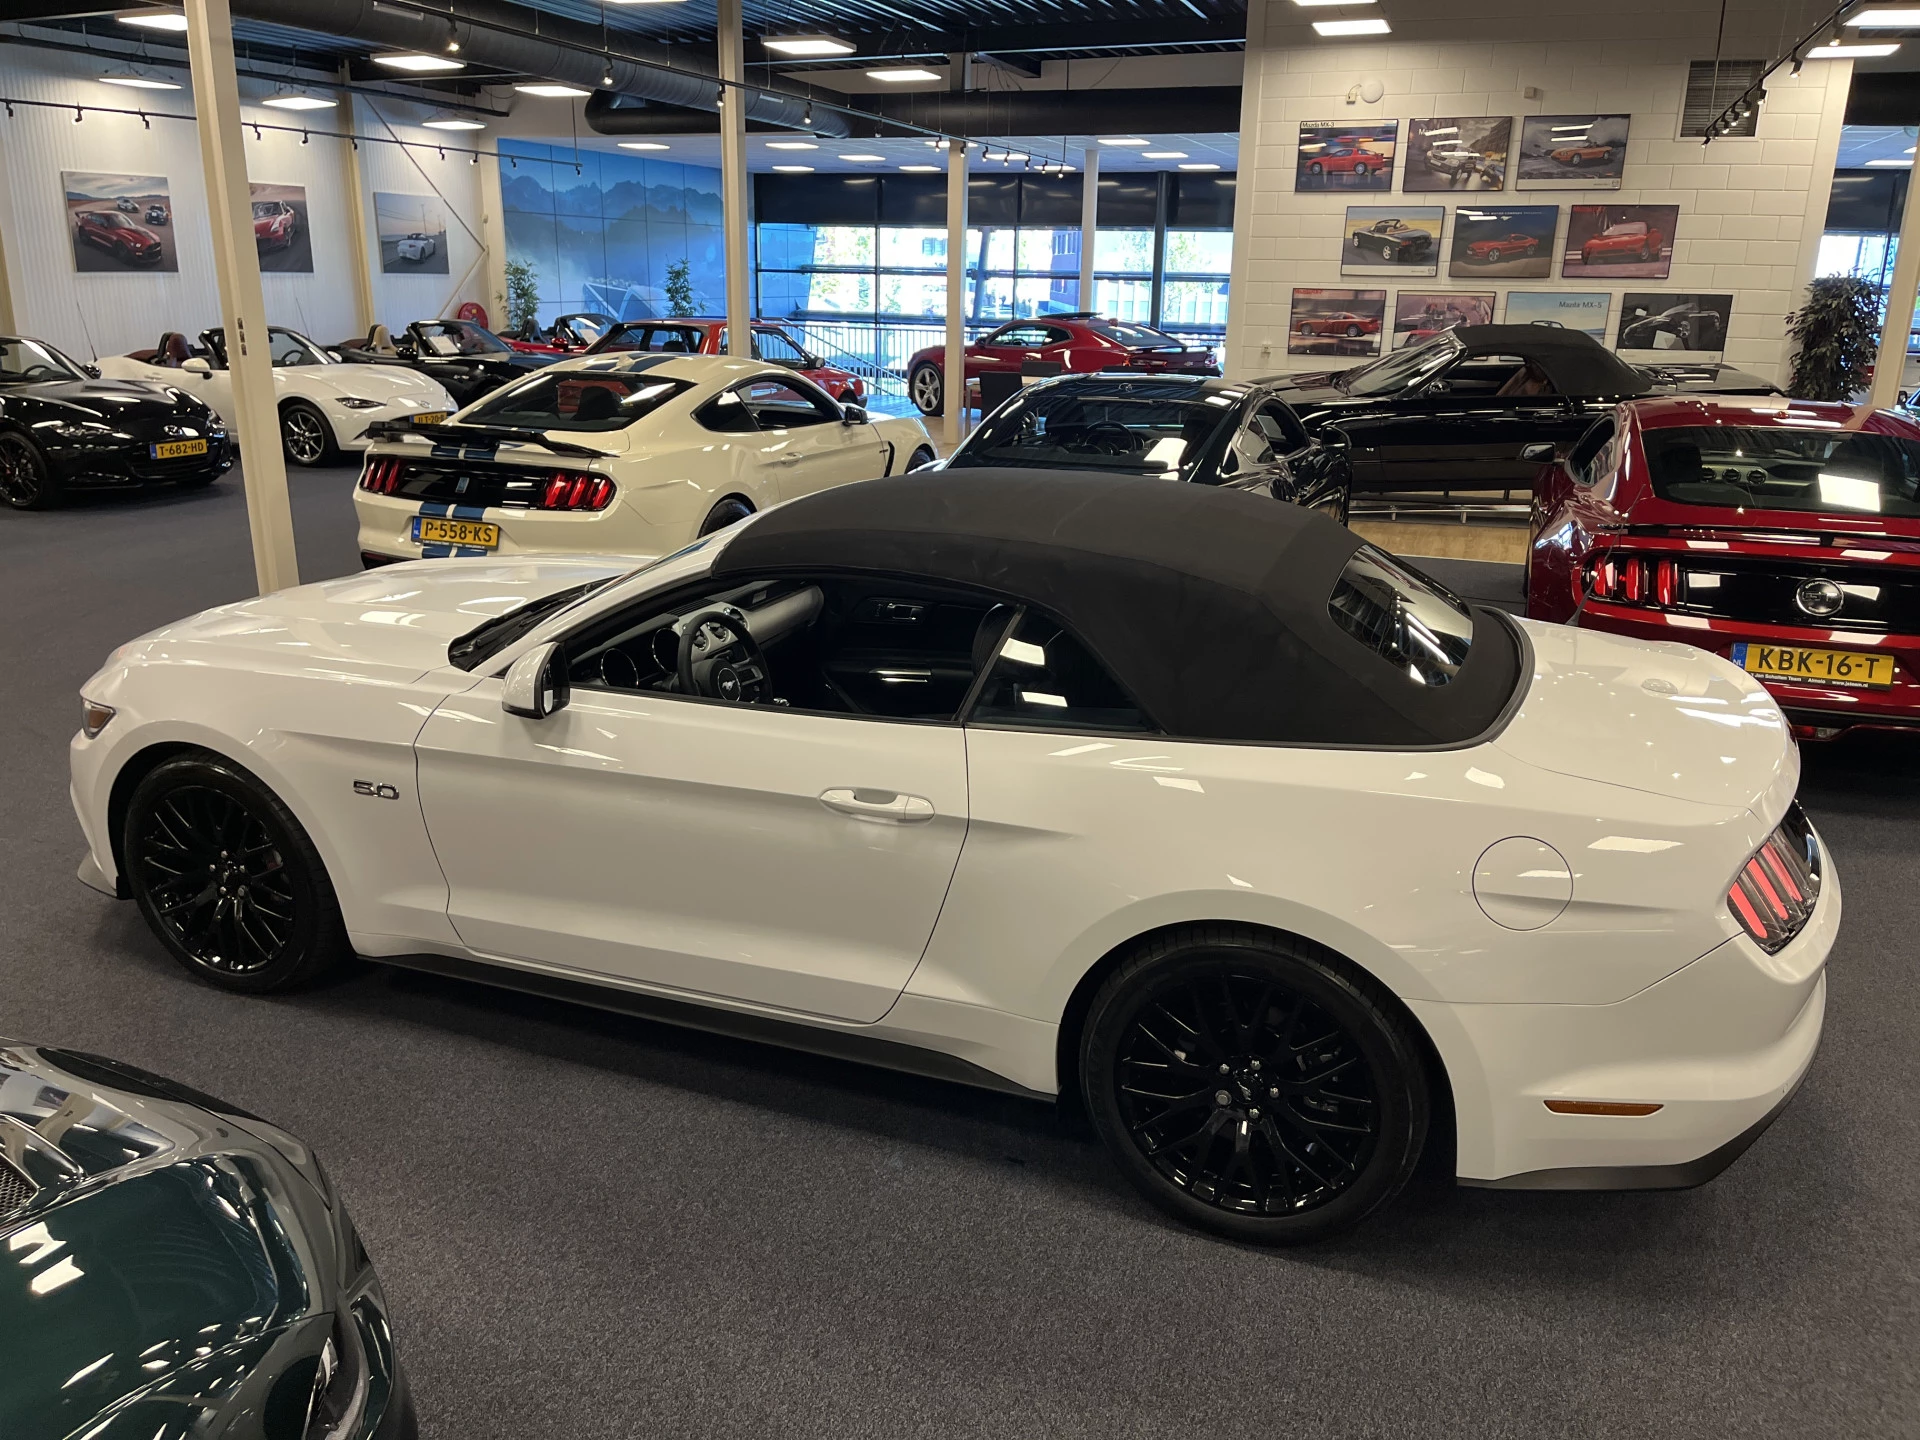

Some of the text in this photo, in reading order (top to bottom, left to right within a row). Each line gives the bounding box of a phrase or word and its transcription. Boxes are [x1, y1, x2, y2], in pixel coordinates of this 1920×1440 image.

[1558, 300, 1602, 309] Mazda MX-5
[159, 441, 204, 457] T-682-HD
[424, 521, 493, 542] P-558-KS
[1732, 658, 1744, 667] NL
[1758, 648, 1880, 679] KBK-16-T
